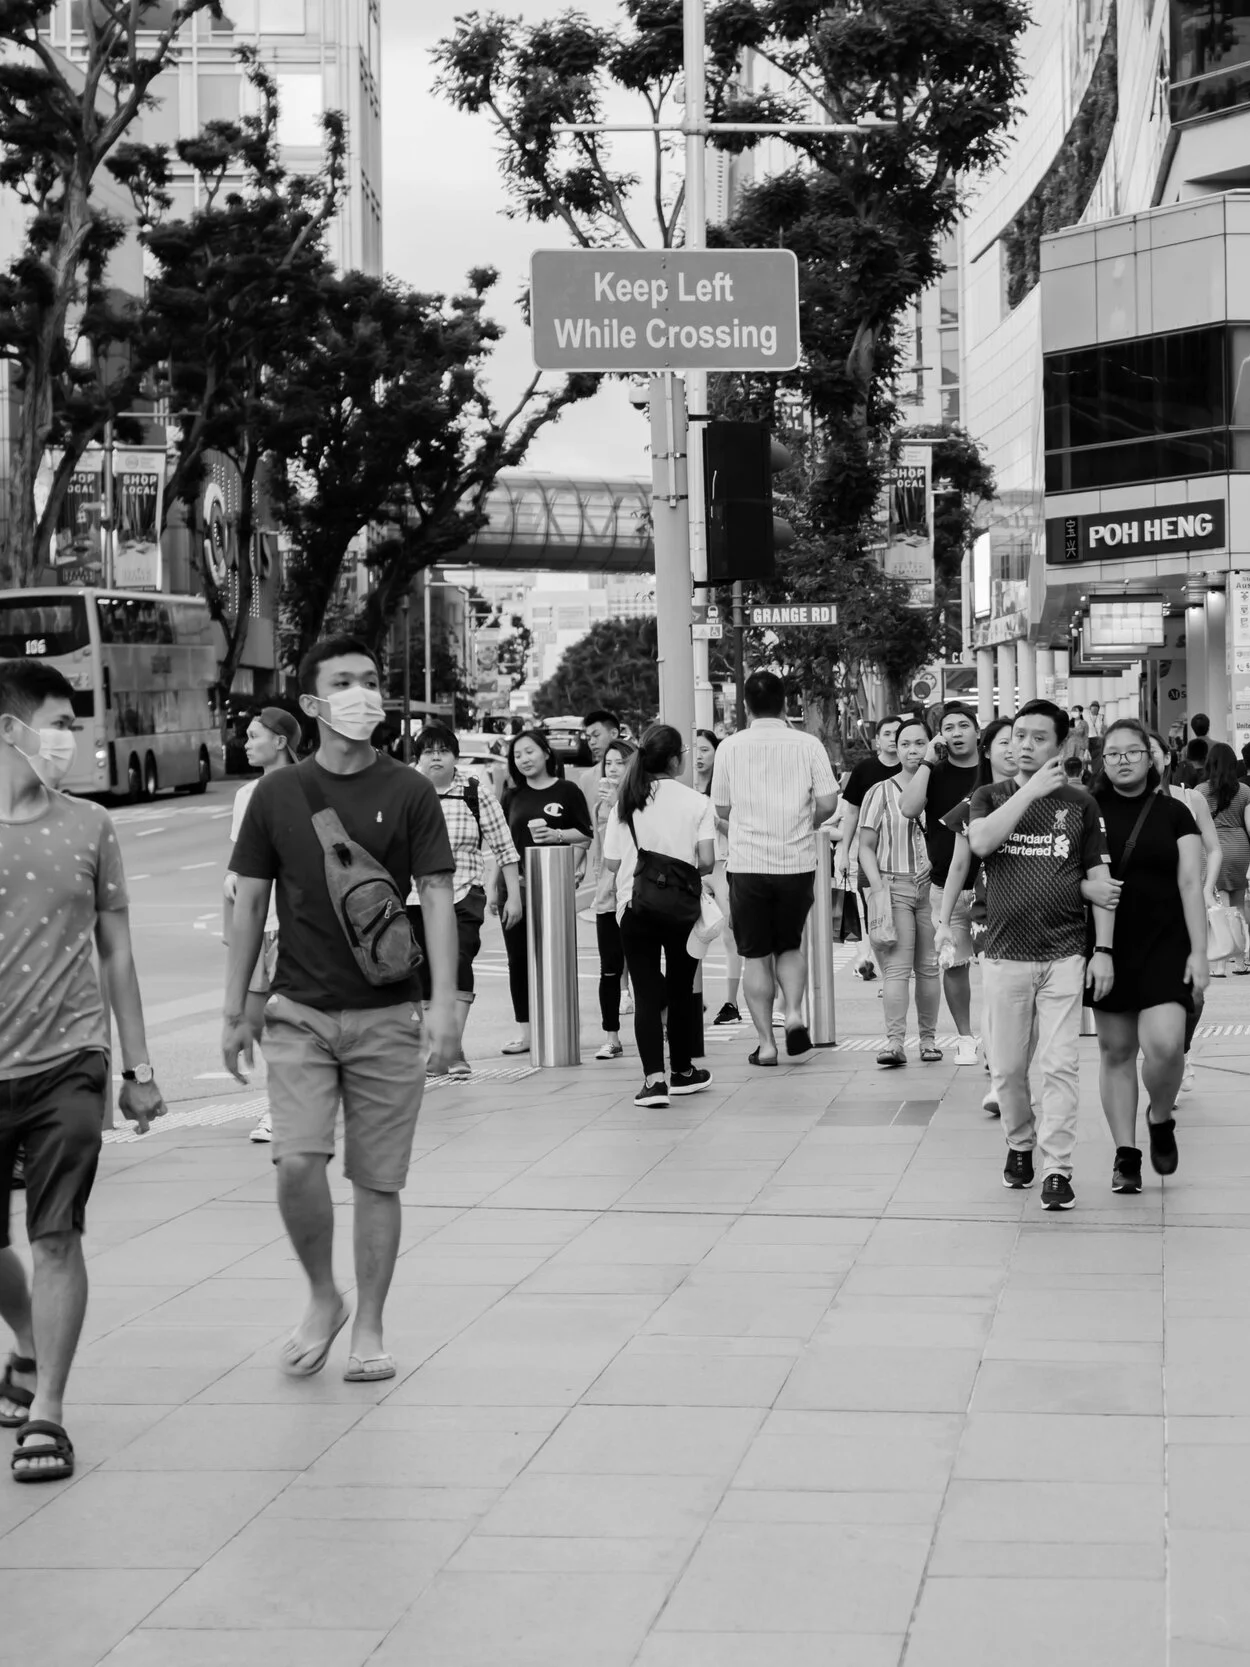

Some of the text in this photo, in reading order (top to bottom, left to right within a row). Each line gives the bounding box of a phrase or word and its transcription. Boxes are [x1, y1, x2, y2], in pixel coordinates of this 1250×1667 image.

[594, 271, 735, 309] Keep Left
[553, 318, 778, 356] While Crossing
[69, 472, 96, 484] HOP
[122, 474, 158, 485] SHOP
[890, 468, 925, 479] SHOP
[67, 484, 96, 494] OCAL
[121, 486, 157, 495] LOCAL
[1088, 513, 1214, 548] POH HENG
[753, 606, 830, 624] GRANGE RD
